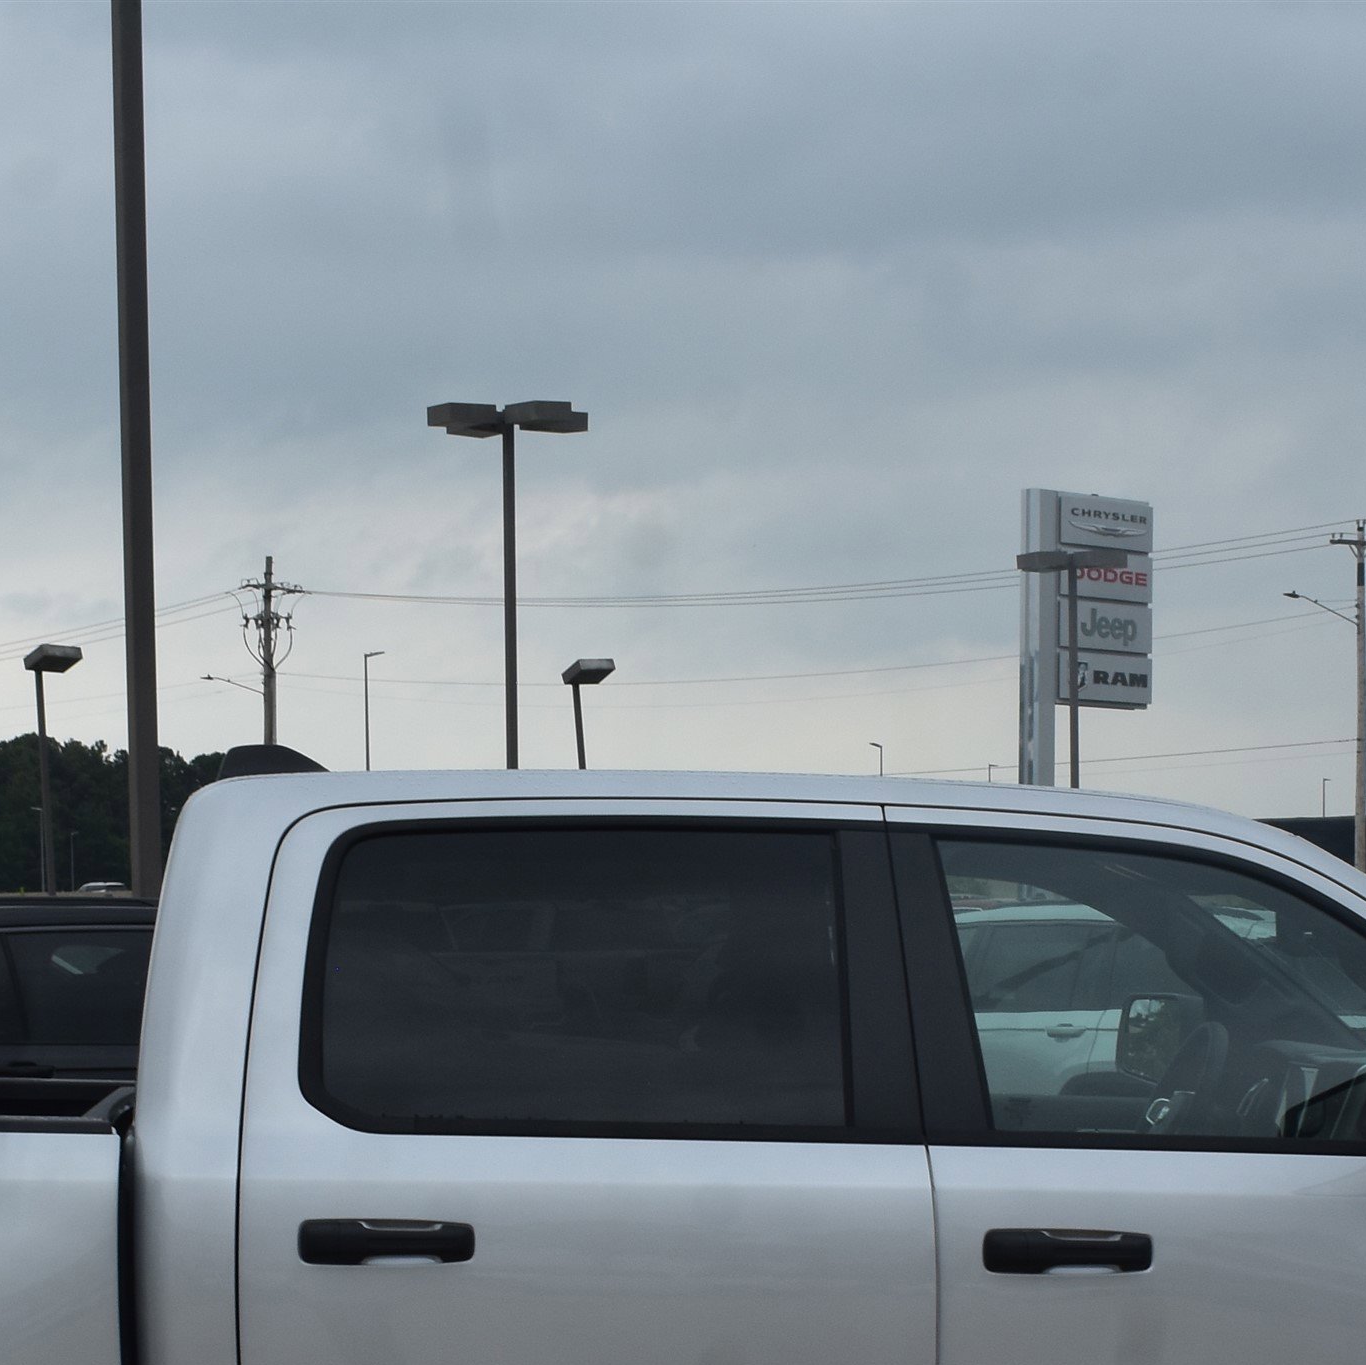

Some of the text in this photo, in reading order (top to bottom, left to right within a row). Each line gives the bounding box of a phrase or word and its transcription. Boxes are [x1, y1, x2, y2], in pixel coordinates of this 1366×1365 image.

[1070, 507, 1147, 525] CHRYSLER
[1081, 608, 1137, 646] Jeep
[1093, 669, 1148, 688] RAM
